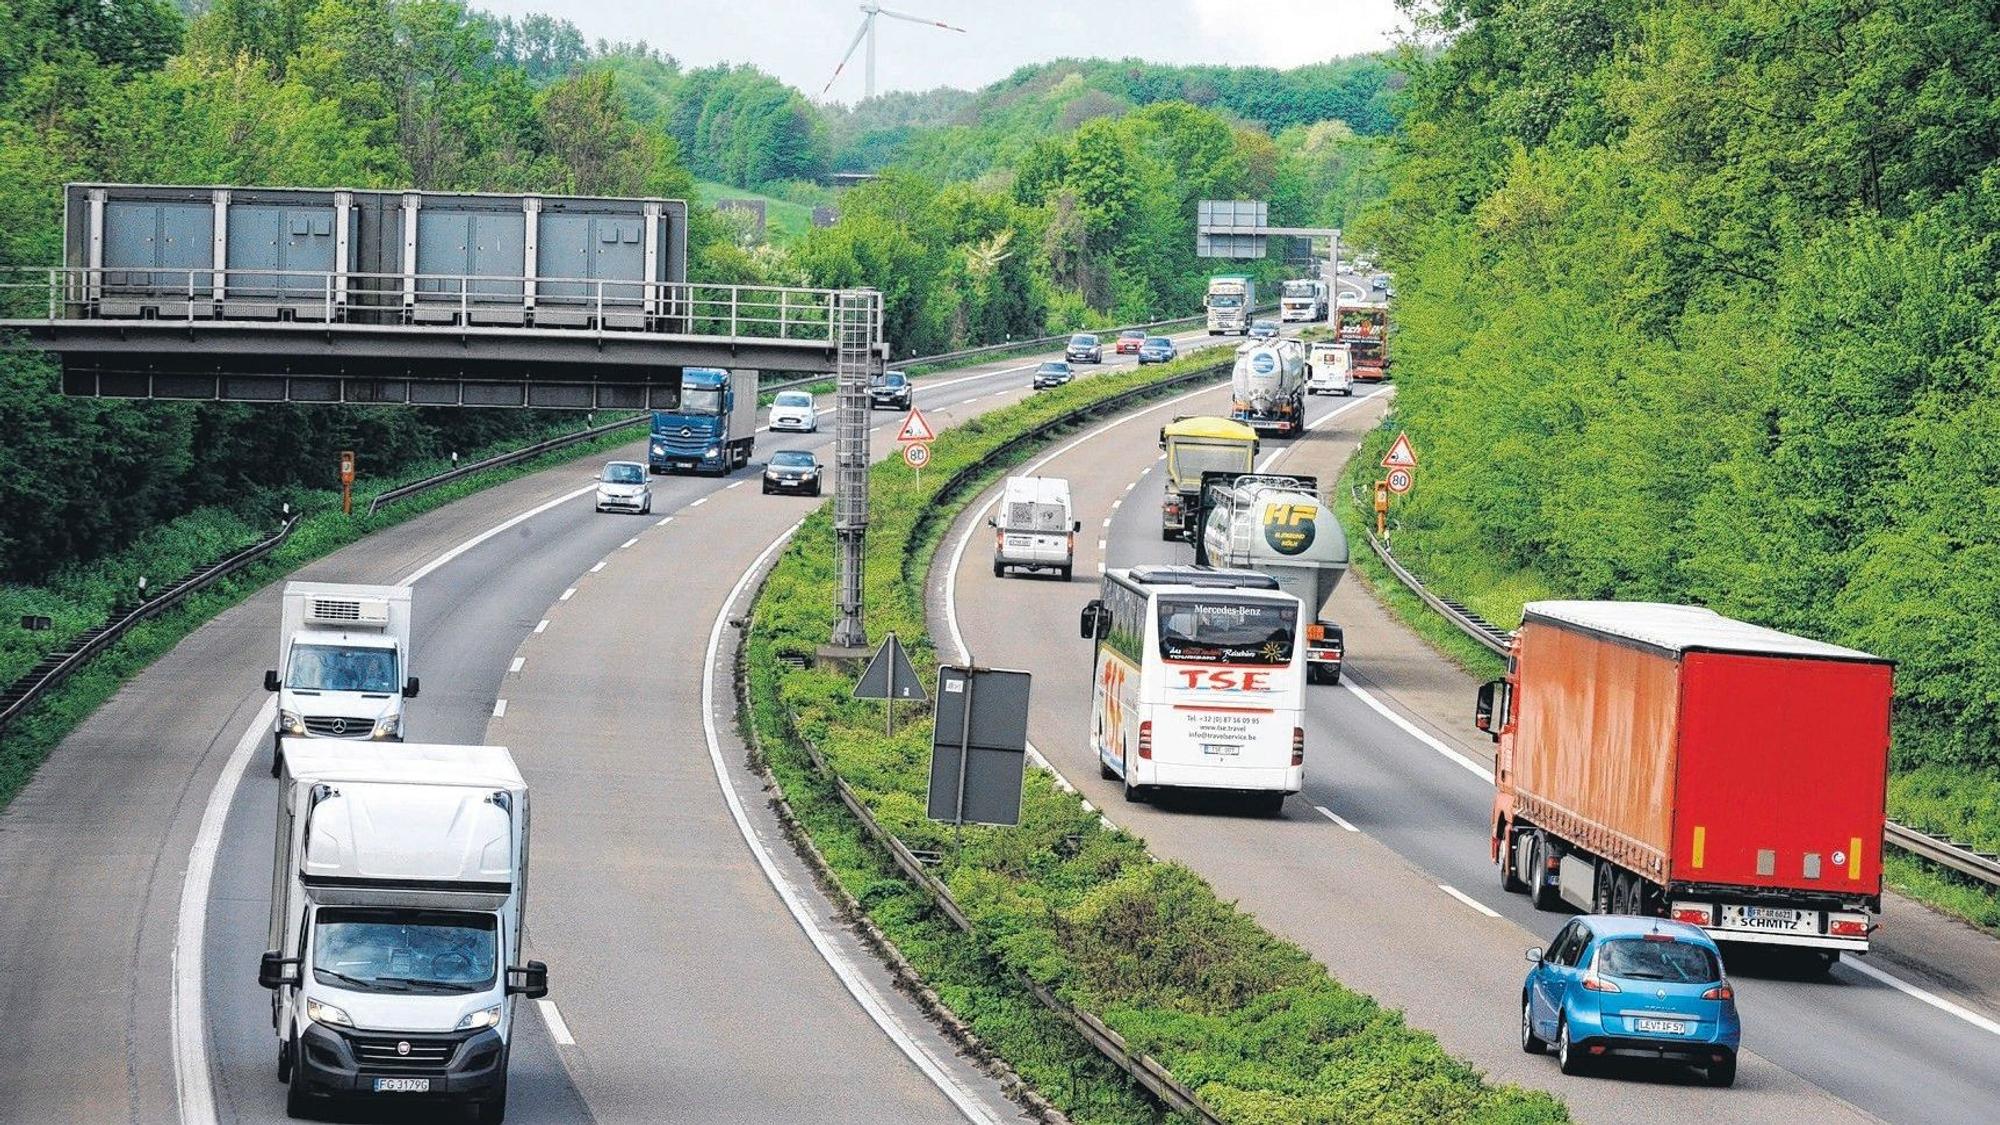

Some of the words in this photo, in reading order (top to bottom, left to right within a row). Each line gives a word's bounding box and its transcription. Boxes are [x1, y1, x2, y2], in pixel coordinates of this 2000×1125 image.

[910, 449, 924, 461] 80
[1392, 475, 1406, 486] 80
[1264, 502, 1318, 526] HF
[1194, 604, 1261, 616] Mercedes-Benz
[1179, 669, 1271, 691] TSE
[1189, 731, 1257, 740] info@travelservice.be
[1741, 918, 1798, 930] SCHMITZ
[1640, 1020, 1657, 1030] LEV
[1662, 1022, 1672, 1030] IF
[1673, 1022, 1684, 1032] 57
[378, 1080, 395, 1090] FG
[397, 1080, 428, 1089] 3179G
